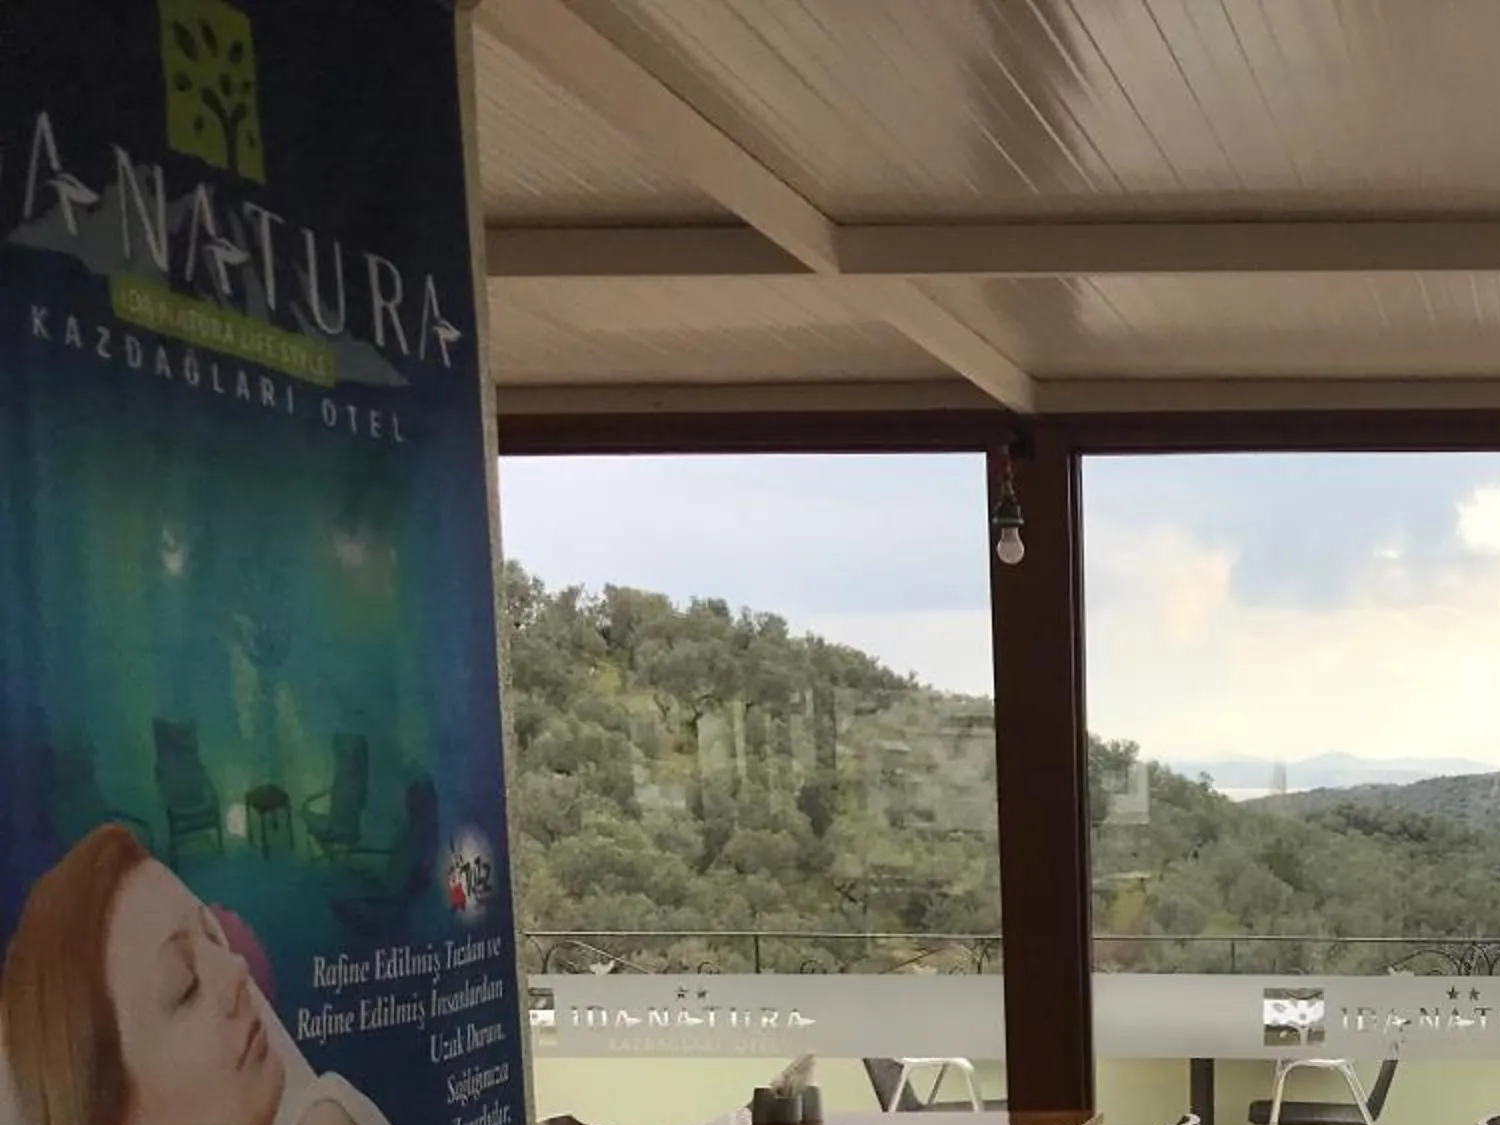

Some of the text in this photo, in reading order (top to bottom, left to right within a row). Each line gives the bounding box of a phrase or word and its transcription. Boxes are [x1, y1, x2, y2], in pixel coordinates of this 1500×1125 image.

[321, 398, 404, 442] OTEL
[313, 953, 369, 995] Rafine
[297, 1004, 355, 1045] Rafine
[360, 991, 426, 1036] Edilmiş
